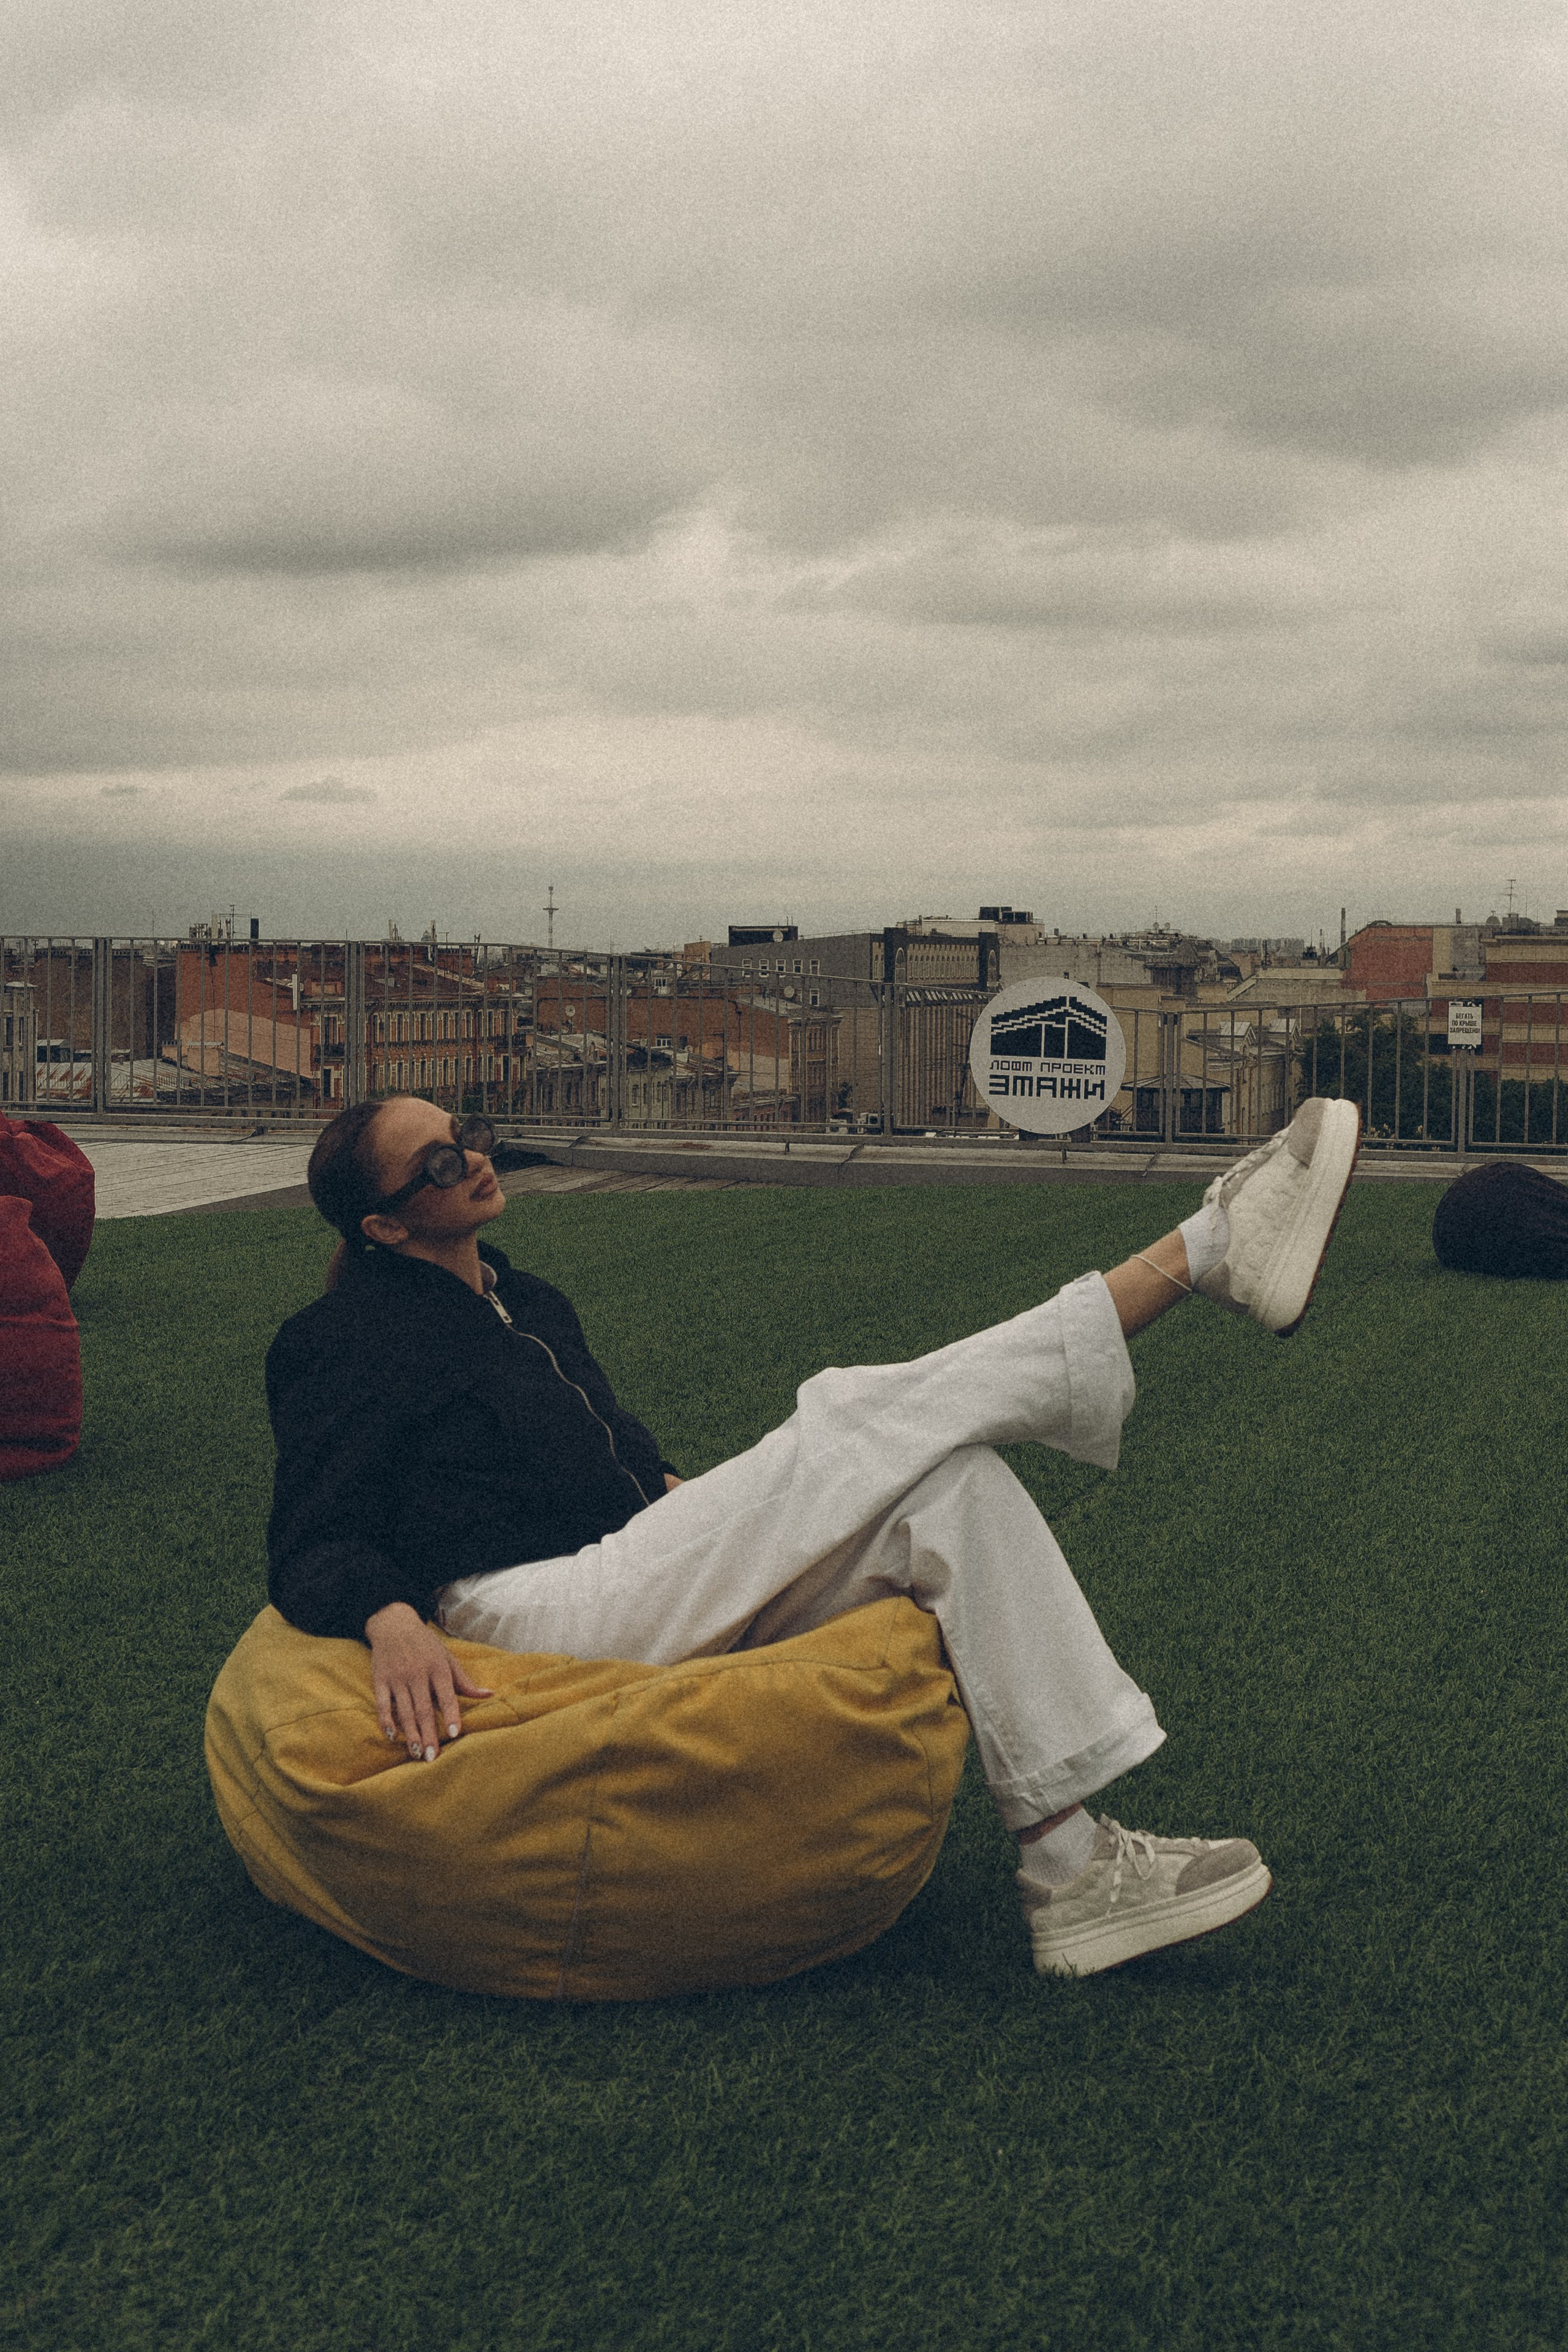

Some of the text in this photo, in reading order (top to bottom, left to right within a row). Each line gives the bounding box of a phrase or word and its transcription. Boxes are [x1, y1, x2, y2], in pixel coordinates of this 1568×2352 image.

[989, 1060, 1106, 1076] ЛОФТ ПРОЕКТ
[989, 1074, 1105, 1101] ЭТАЖИ
